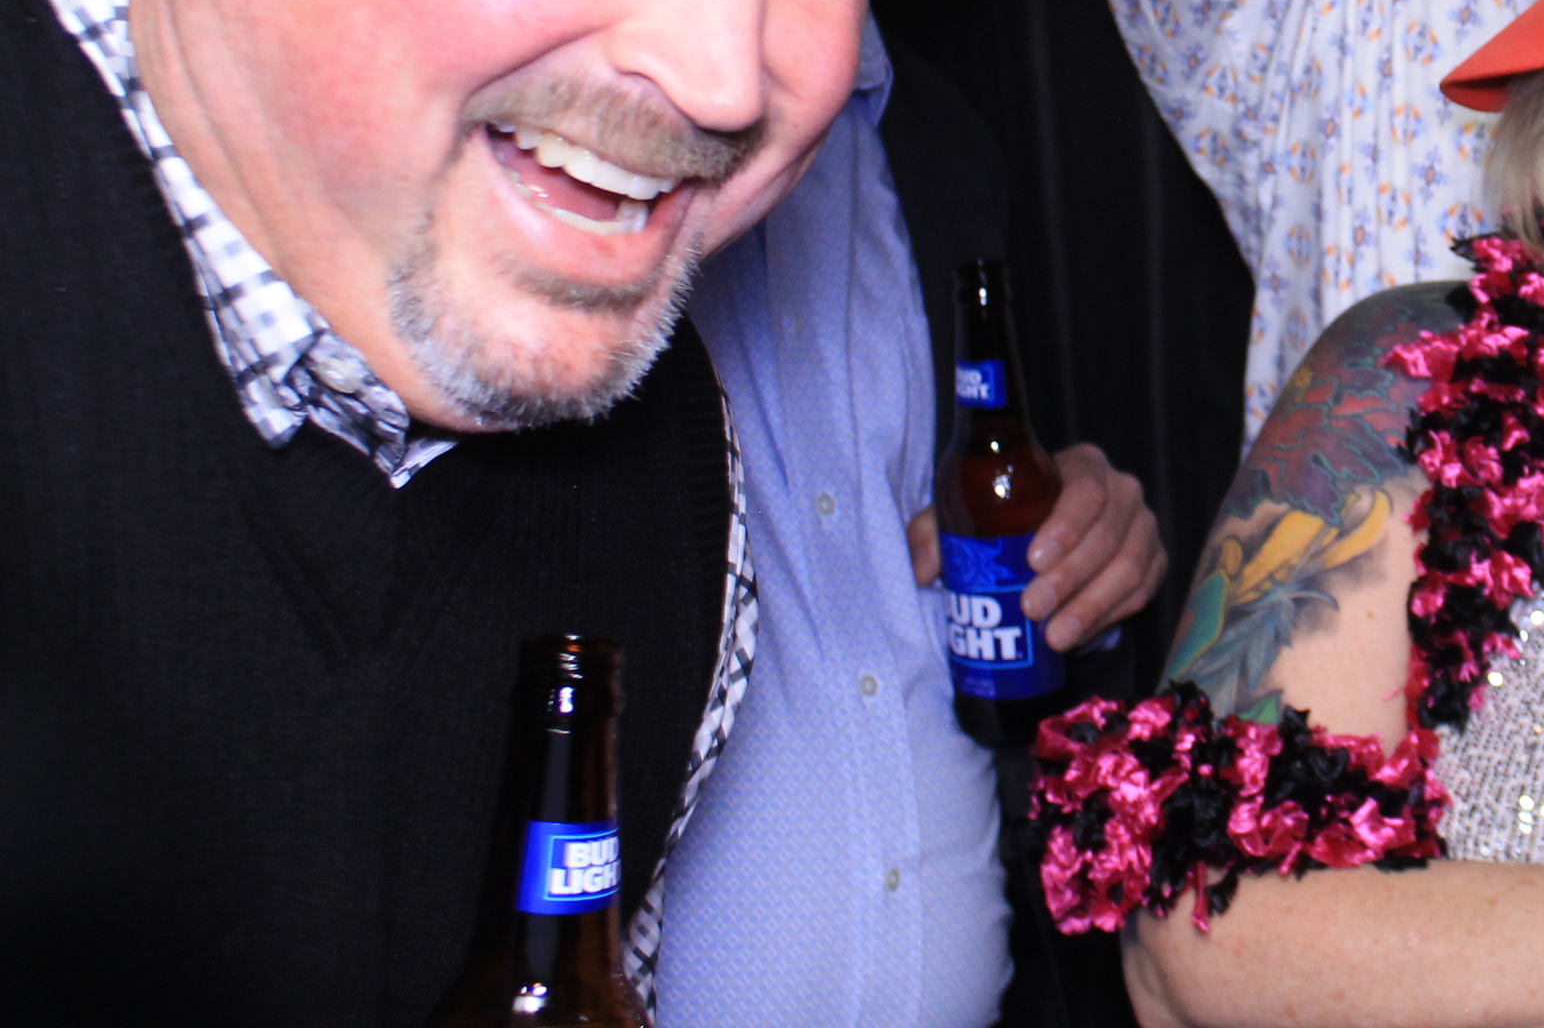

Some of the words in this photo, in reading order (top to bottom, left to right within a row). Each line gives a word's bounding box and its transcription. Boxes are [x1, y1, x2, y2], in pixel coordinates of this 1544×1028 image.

[955, 368, 982, 384] UD
[949, 593, 1002, 629] UD
[949, 623, 1022, 661] GHT
[550, 859, 621, 895] LIGH
